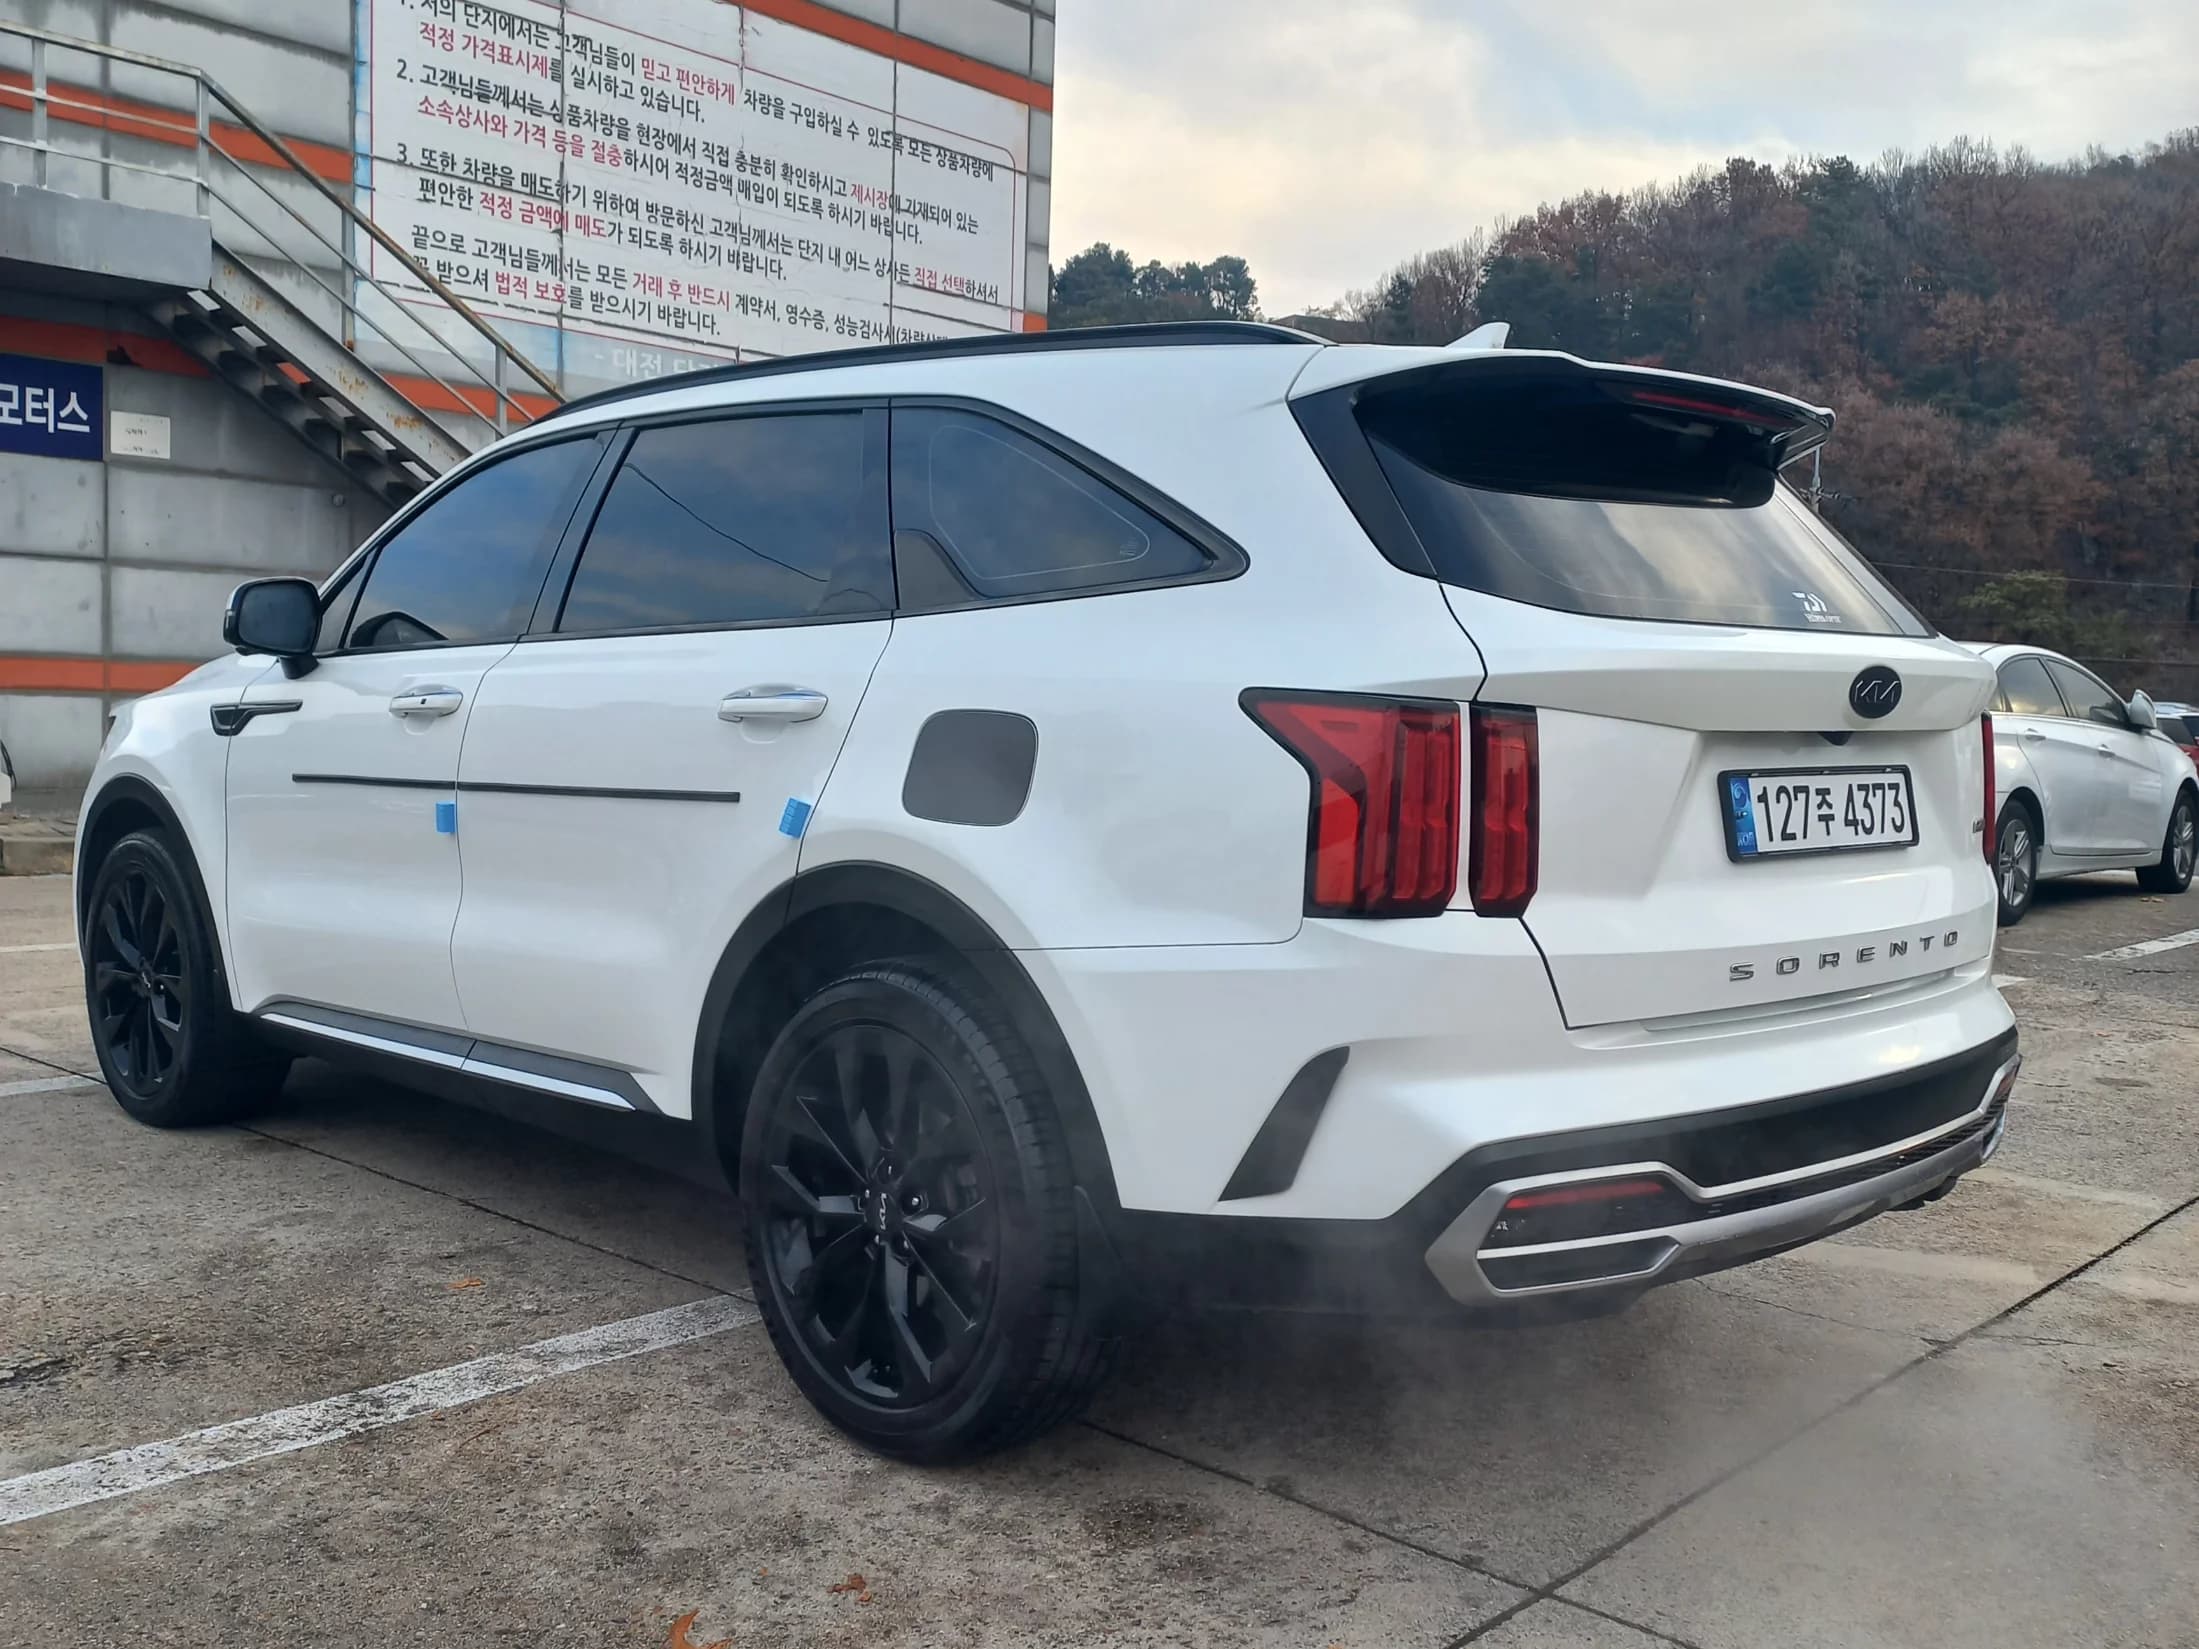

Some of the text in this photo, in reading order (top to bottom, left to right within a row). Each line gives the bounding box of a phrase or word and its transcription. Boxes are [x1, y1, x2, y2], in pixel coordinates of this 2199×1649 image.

[420, 21, 705, 124] 적정 가격표시제를 실시하고 있습니다.
[421, 0, 456, 23] 저의
[463, 2, 551, 49] 단지에서는
[555, 31, 635, 76] 고객님들이
[641, 57, 672, 82] 믿고
[676, 66, 735, 106] 편안하게
[743, 88, 785, 119] 차량을
[789, 102, 843, 137] 구입하실
[846, 120, 860, 141] 수
[867, 126, 905, 155] 있도록
[907, 136, 932, 164] 모든
[935, 148, 994, 182] 상품차량에
[396, 58, 414, 83] 2.
[419, 63, 545, 118] 고객님들께서는
[550, 99, 631, 142] 상품차량을
[635, 122, 697, 160] 현장에서
[702, 140, 730, 168] 직접
[734, 150, 776, 181] 충분히
[780, 162, 848, 198] 확인하시고
[850, 183, 901, 215] 제시장에
[956, 211, 979, 235] 있는
[417, 95, 923, 245] 소속상사와 가격 등을 절충하시어 적정금액 매입이 되도록 하시기 바랍니다.
[396, 142, 999, 305] 3. 또한 차량을 매도하기 위하여 방문하신 고객님께서는 단지 내 어느 상사든 직접 선택하셔서
[417, 177, 787, 281] 편안한 적정 금액에 매도가 되도록 하시기 바랍니다.
[411, 224, 467, 255] 끝으로
[472, 238, 591, 283] 고객님들께서는
[595, 263, 628, 290] 모든
[632, 271, 663, 298] 거래
[667, 278, 682, 301] 후
[687, 282, 730, 312] 반드시
[735, 292, 781, 323] 계약서,
[785, 302, 829, 333] 영수증,
[436, 258, 489, 293] 받으셔
[495, 270, 527, 300] 법적
[534, 279, 585, 310] 보호를
[590, 290, 651, 323] 받으시기
[657, 304, 721, 336] 바랍니다.
[1757, 781, 1906, 844] 127주 4373
[1729, 930, 1959, 982] SORENTO
